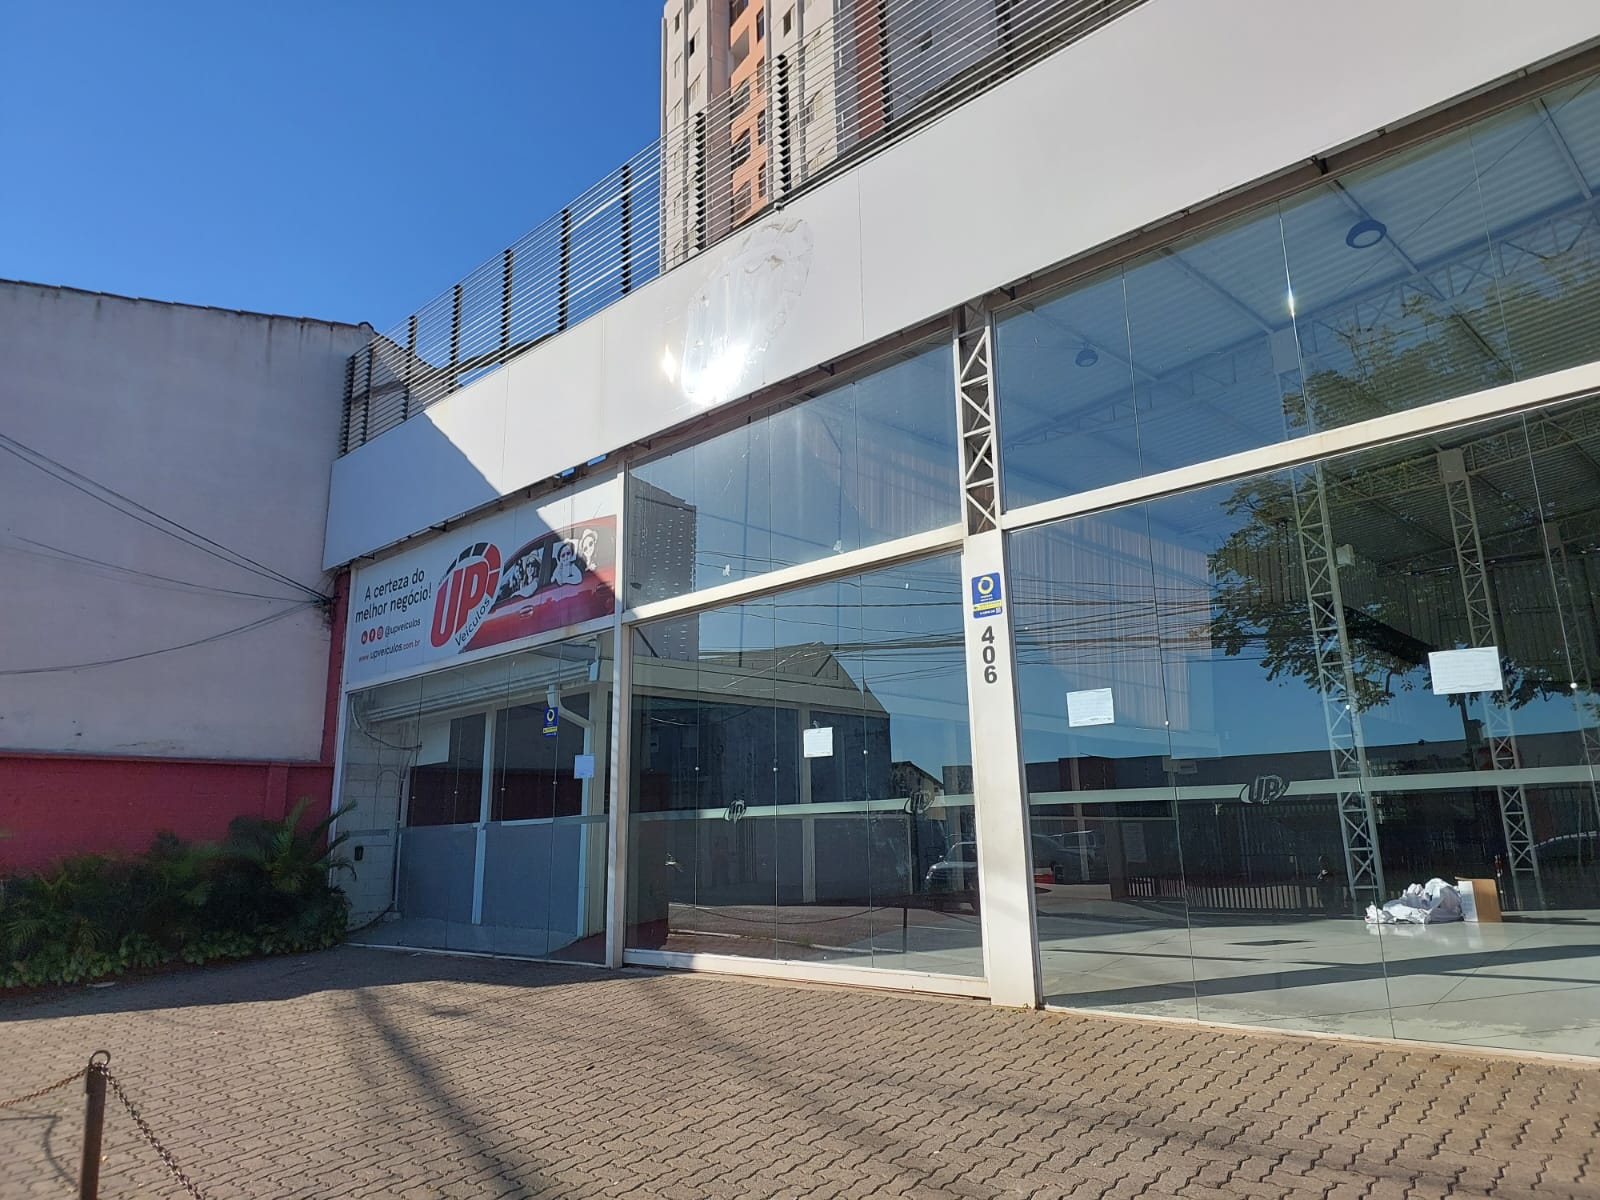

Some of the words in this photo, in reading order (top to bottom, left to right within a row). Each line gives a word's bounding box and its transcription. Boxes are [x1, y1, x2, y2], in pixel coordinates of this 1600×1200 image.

[355, 602, 388, 623] melhor
[390, 582, 432, 613] negócio!
[365, 586, 371, 602] A
[373, 574, 409, 598] certeza
[412, 567, 425, 584] do
[981, 625, 998, 684] 406
